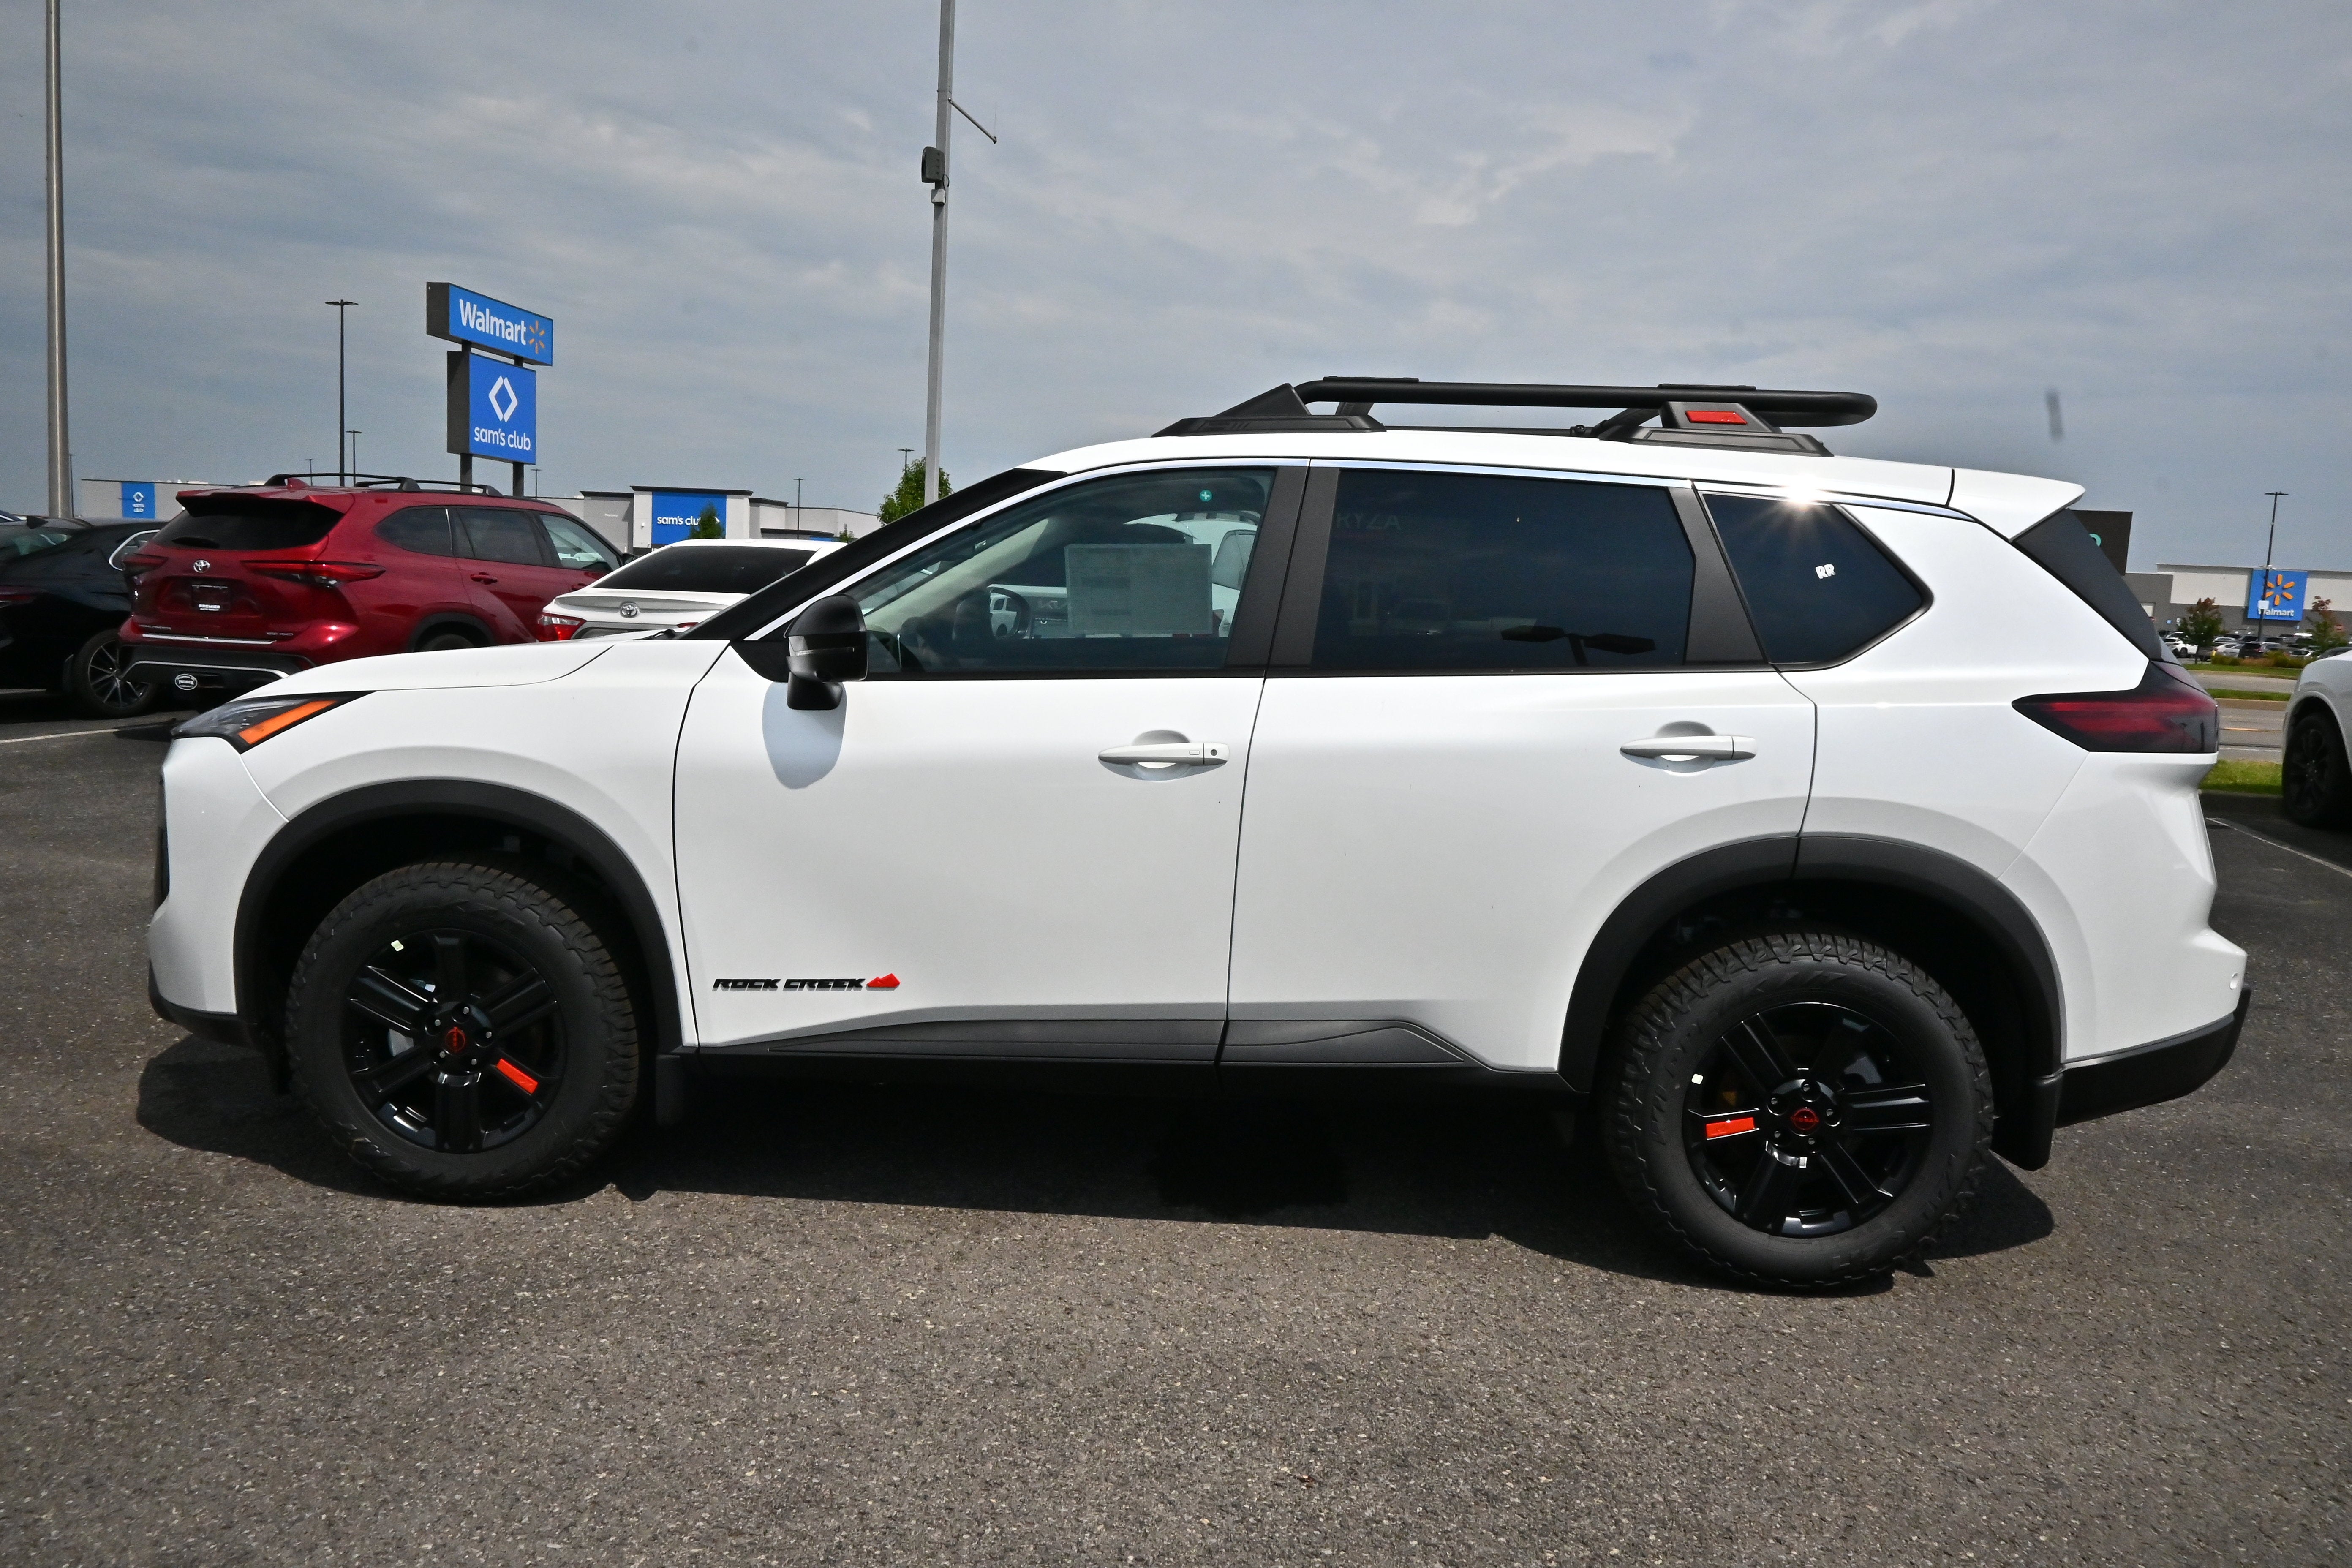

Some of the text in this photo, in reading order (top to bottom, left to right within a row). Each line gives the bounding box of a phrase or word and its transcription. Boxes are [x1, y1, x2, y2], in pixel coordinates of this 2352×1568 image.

[460, 299, 526, 345] Walmart
[474, 427, 531, 451] sam's club
[657, 516, 683, 525] sam's
[1816, 564, 1836, 579] RR
[713, 978, 866, 988] ROCK CREEK
